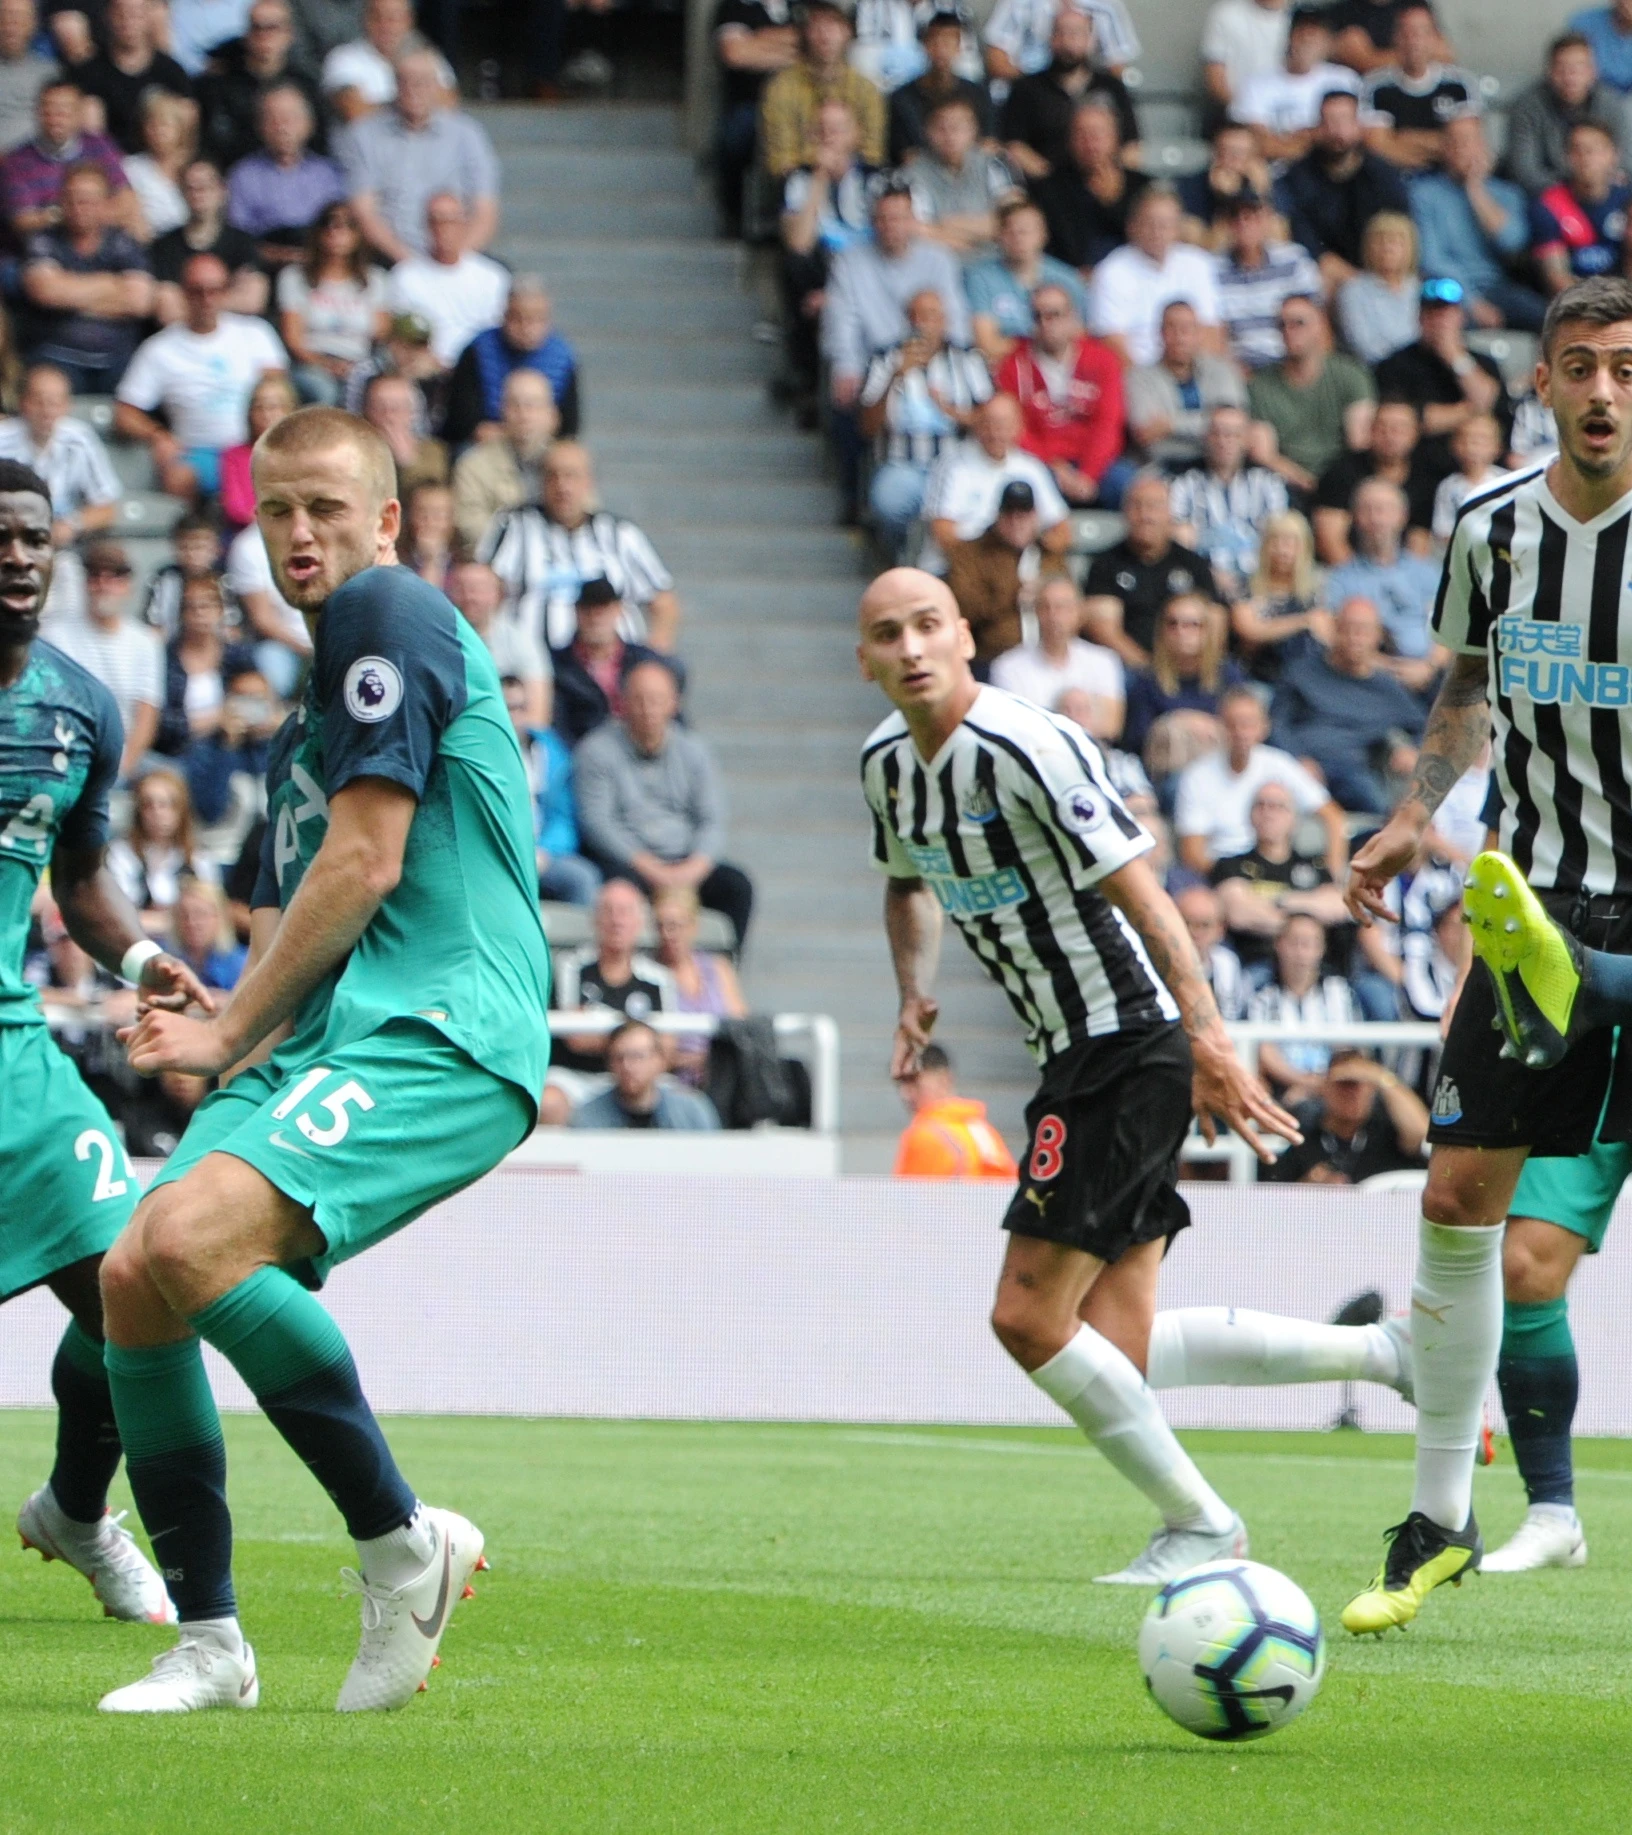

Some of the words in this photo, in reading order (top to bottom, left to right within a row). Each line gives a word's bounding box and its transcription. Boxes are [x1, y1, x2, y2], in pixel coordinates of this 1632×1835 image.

[1500, 615, 1582, 658] 乐天堂
[271, 1067, 376, 1148] 15
[1029, 1113, 1067, 1181] 8
